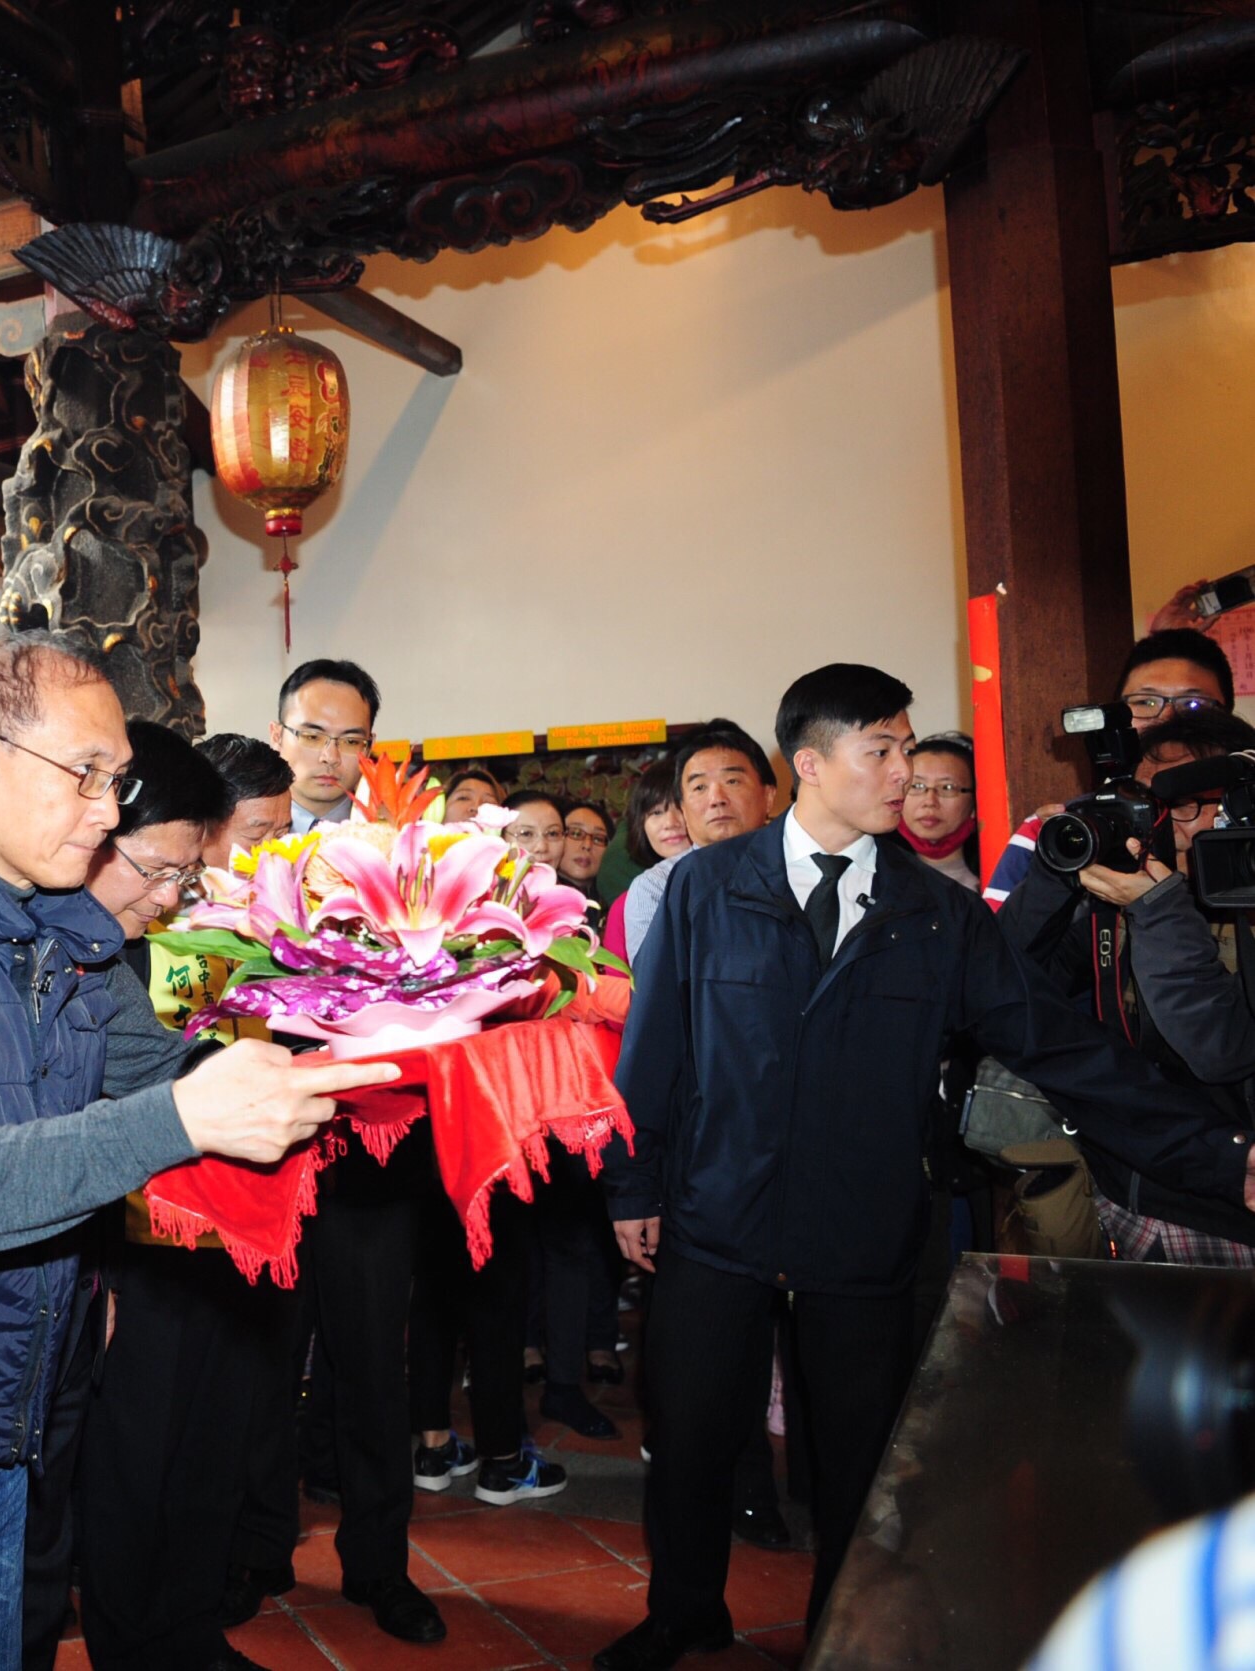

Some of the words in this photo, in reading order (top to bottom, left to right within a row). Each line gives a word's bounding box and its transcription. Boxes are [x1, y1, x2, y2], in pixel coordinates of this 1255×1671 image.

[584, 725, 619, 736] Paper
[566, 737, 592, 747] Free
[597, 733, 651, 746] Donation
[1099, 928, 1112, 968] EOS
